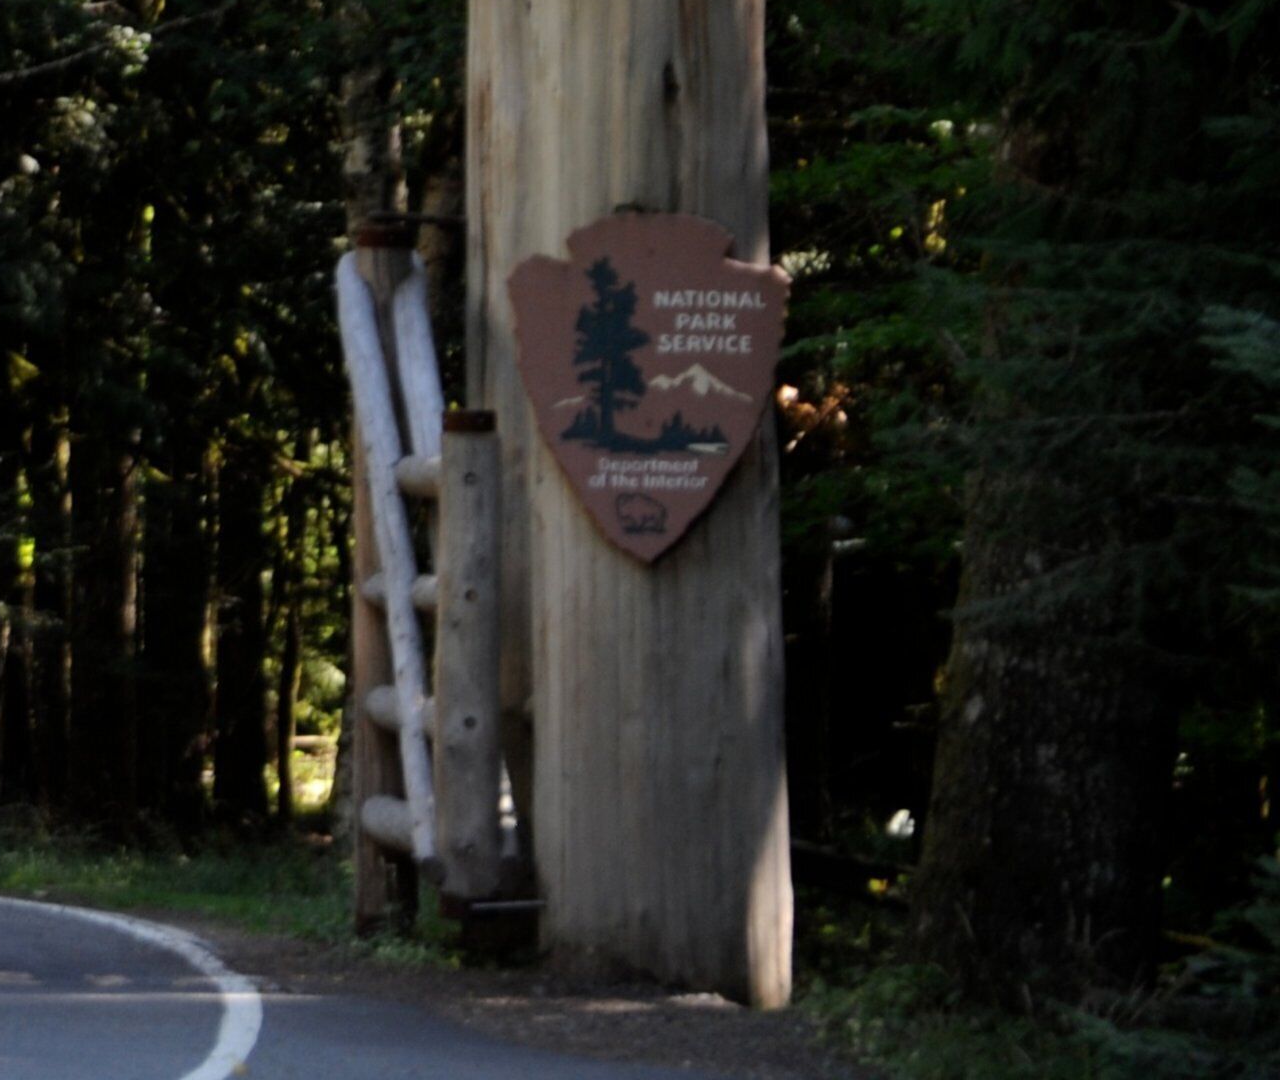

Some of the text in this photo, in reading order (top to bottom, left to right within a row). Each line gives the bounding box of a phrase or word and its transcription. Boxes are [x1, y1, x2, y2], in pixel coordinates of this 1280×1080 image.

[654, 290, 767, 309] NATIONAL
[675, 311, 738, 330] PARK
[657, 334, 753, 354] SERVICE
[598, 457, 699, 473] Department
[589, 474, 709, 488] of the Interior
